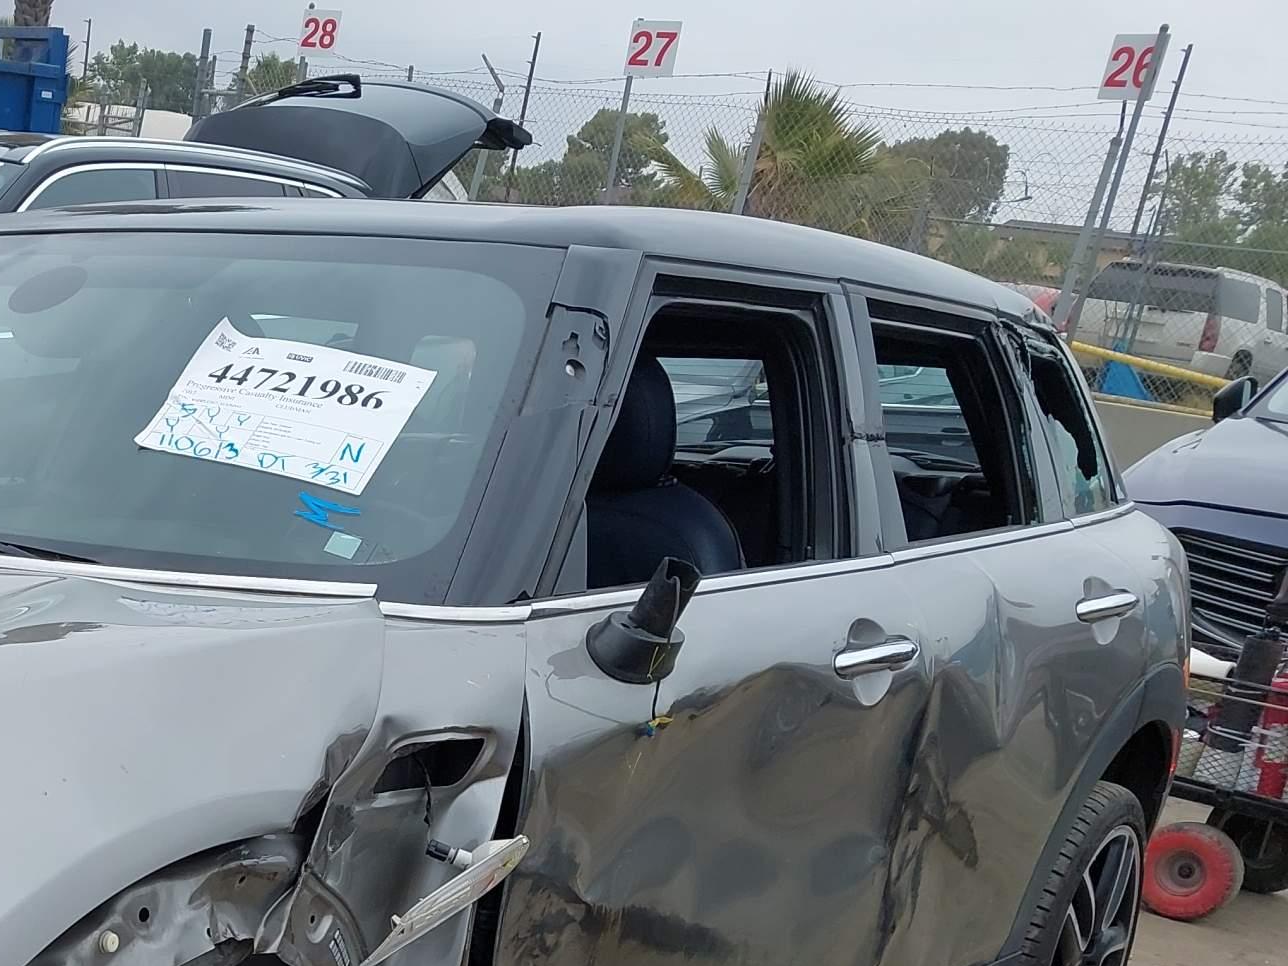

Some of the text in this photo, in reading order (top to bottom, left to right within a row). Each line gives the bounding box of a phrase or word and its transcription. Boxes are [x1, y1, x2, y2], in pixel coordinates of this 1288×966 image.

[300, 17, 337, 49] 28
[627, 30, 678, 67] 27
[1103, 46, 1157, 88] 26
[186, 379, 238, 394] Progressive
[238, 388, 278, 401] Casualty
[279, 394, 324, 409] Insurance
[207, 362, 393, 410] 44721986
[339, 442, 366, 463] N
